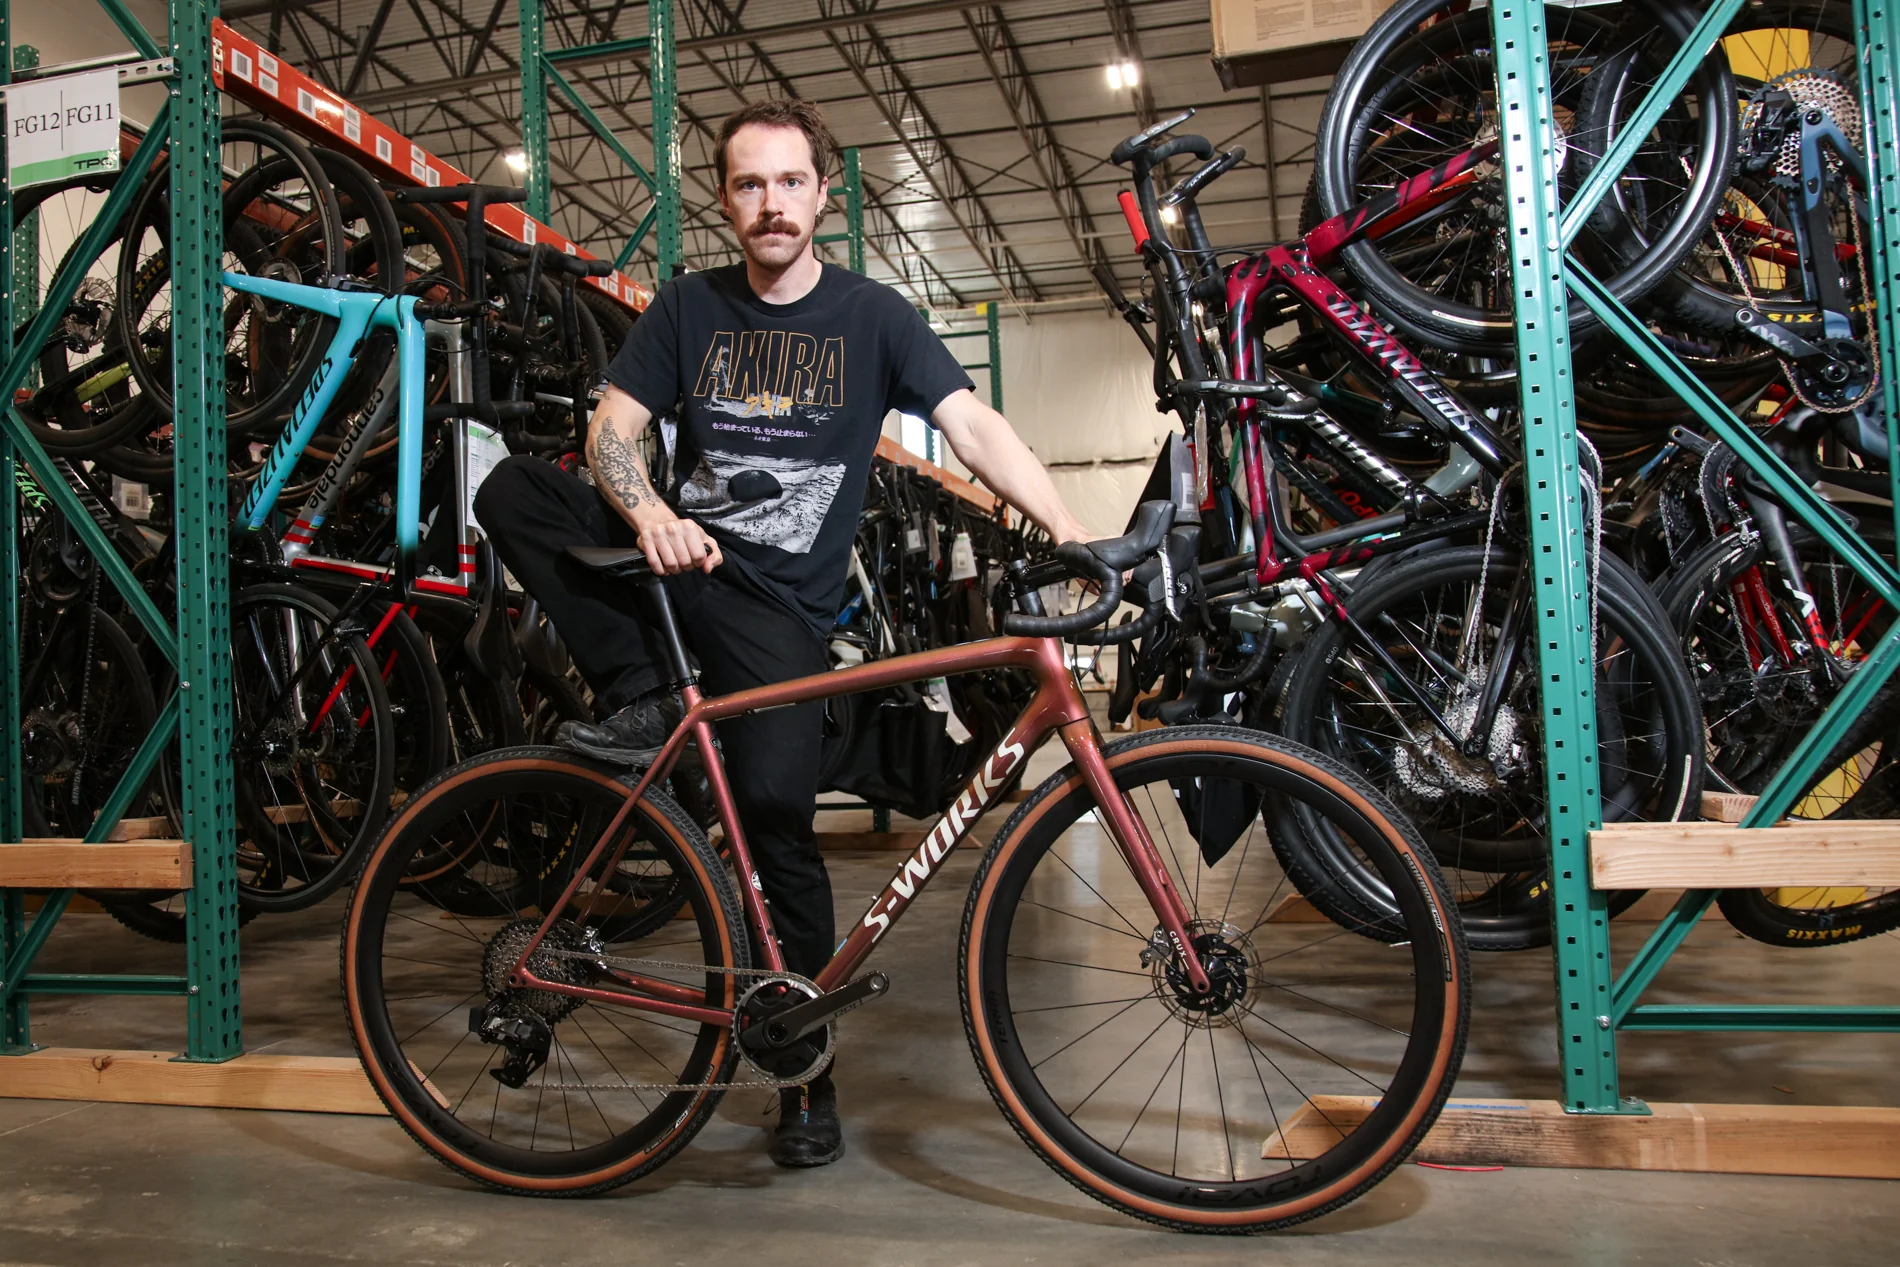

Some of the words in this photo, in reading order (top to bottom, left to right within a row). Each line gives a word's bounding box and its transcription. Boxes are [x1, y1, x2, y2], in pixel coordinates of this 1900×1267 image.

[14, 112, 60, 137] FG12
[66, 103, 114, 126] FG11
[693, 331, 844, 406] AKIRA
[1327, 301, 1474, 431] SPECIALIZED
[743, 390, 794, 419] アキラ
[244, 357, 333, 519] SPECIALIZED
[308, 388, 384, 509] cannondale
[539, 821, 578, 880] MAXXIS
[864, 727, 1025, 943] S-WORKS
[1170, 931, 1187, 957] CRUX
[1786, 924, 1862, 940] MAXXIS
